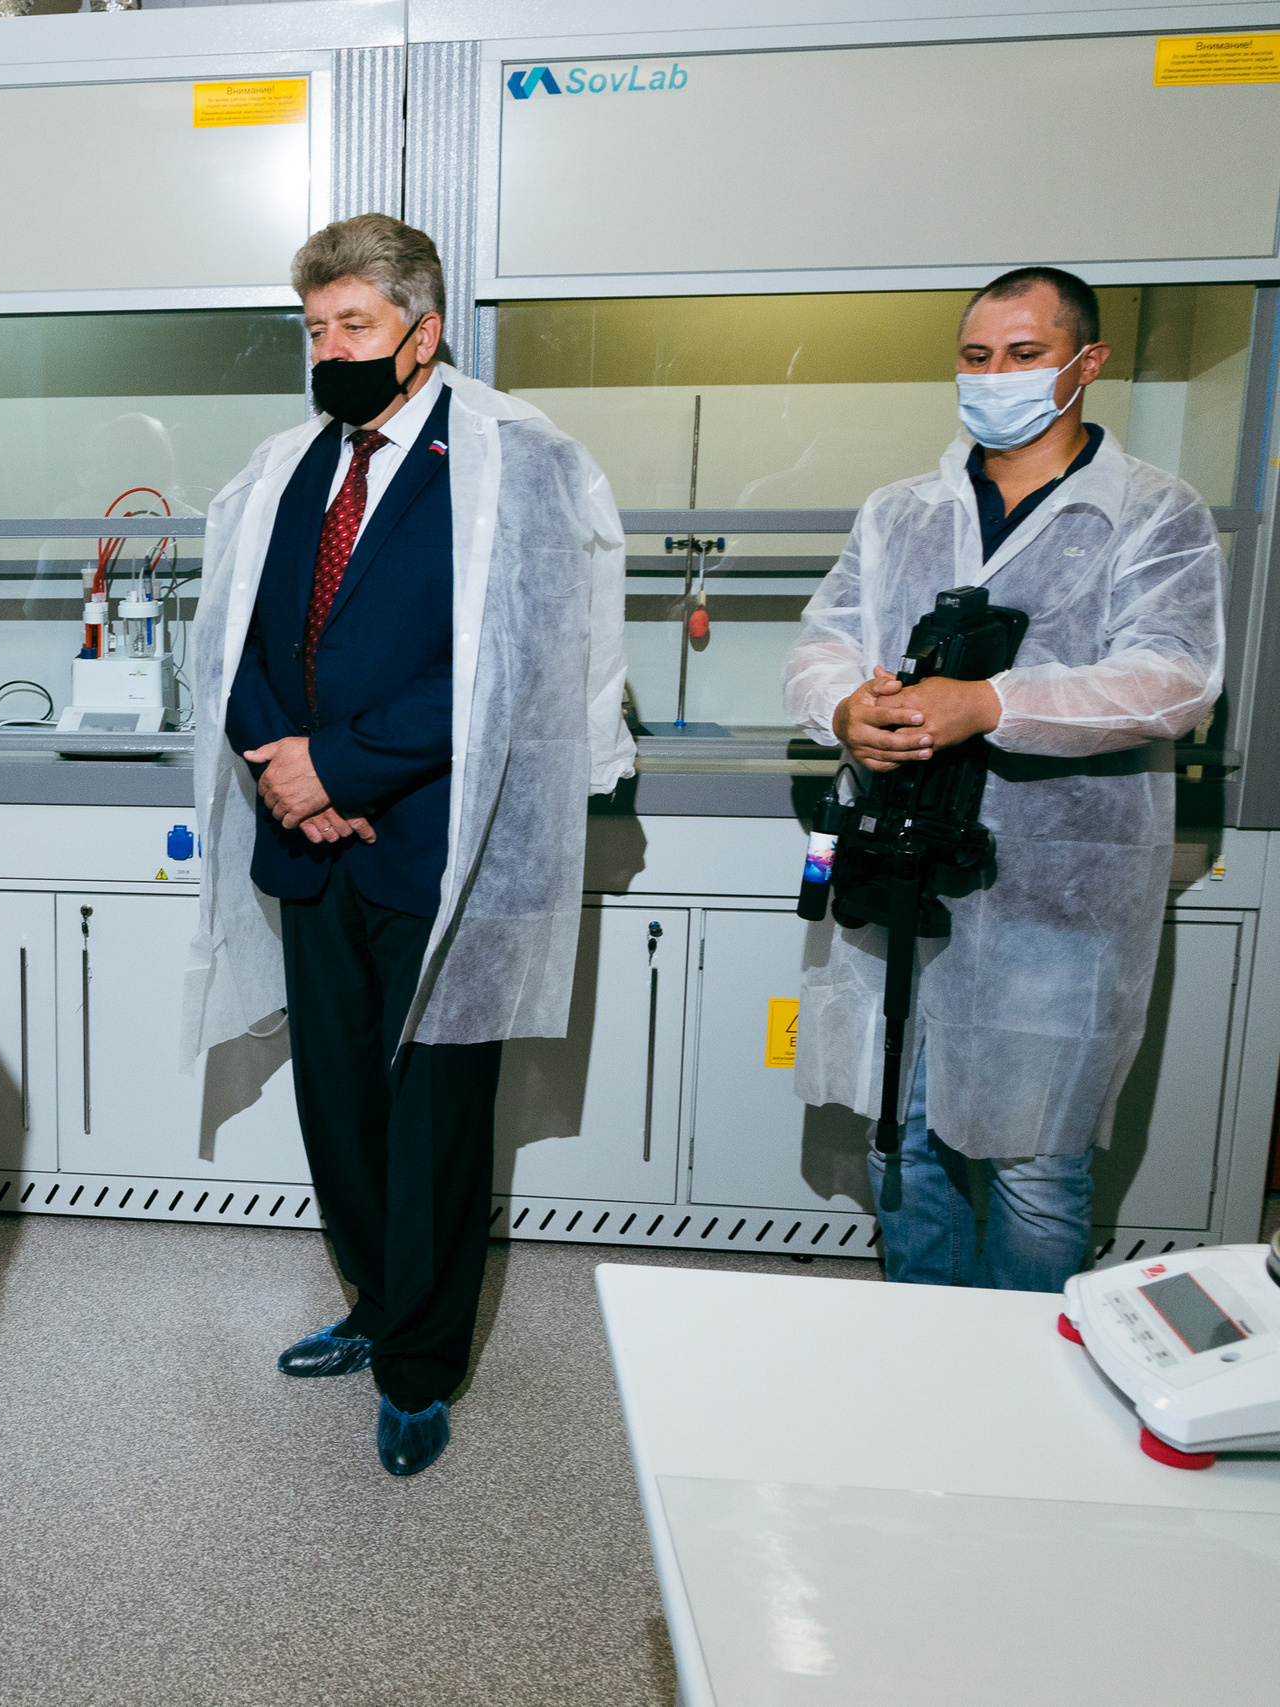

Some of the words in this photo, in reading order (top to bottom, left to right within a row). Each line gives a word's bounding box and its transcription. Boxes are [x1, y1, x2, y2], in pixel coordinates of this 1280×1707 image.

[1195, 40, 1253, 51] Внимание!
[565, 63, 689, 95] SovLab
[226, 85, 275, 96] Внимание!
